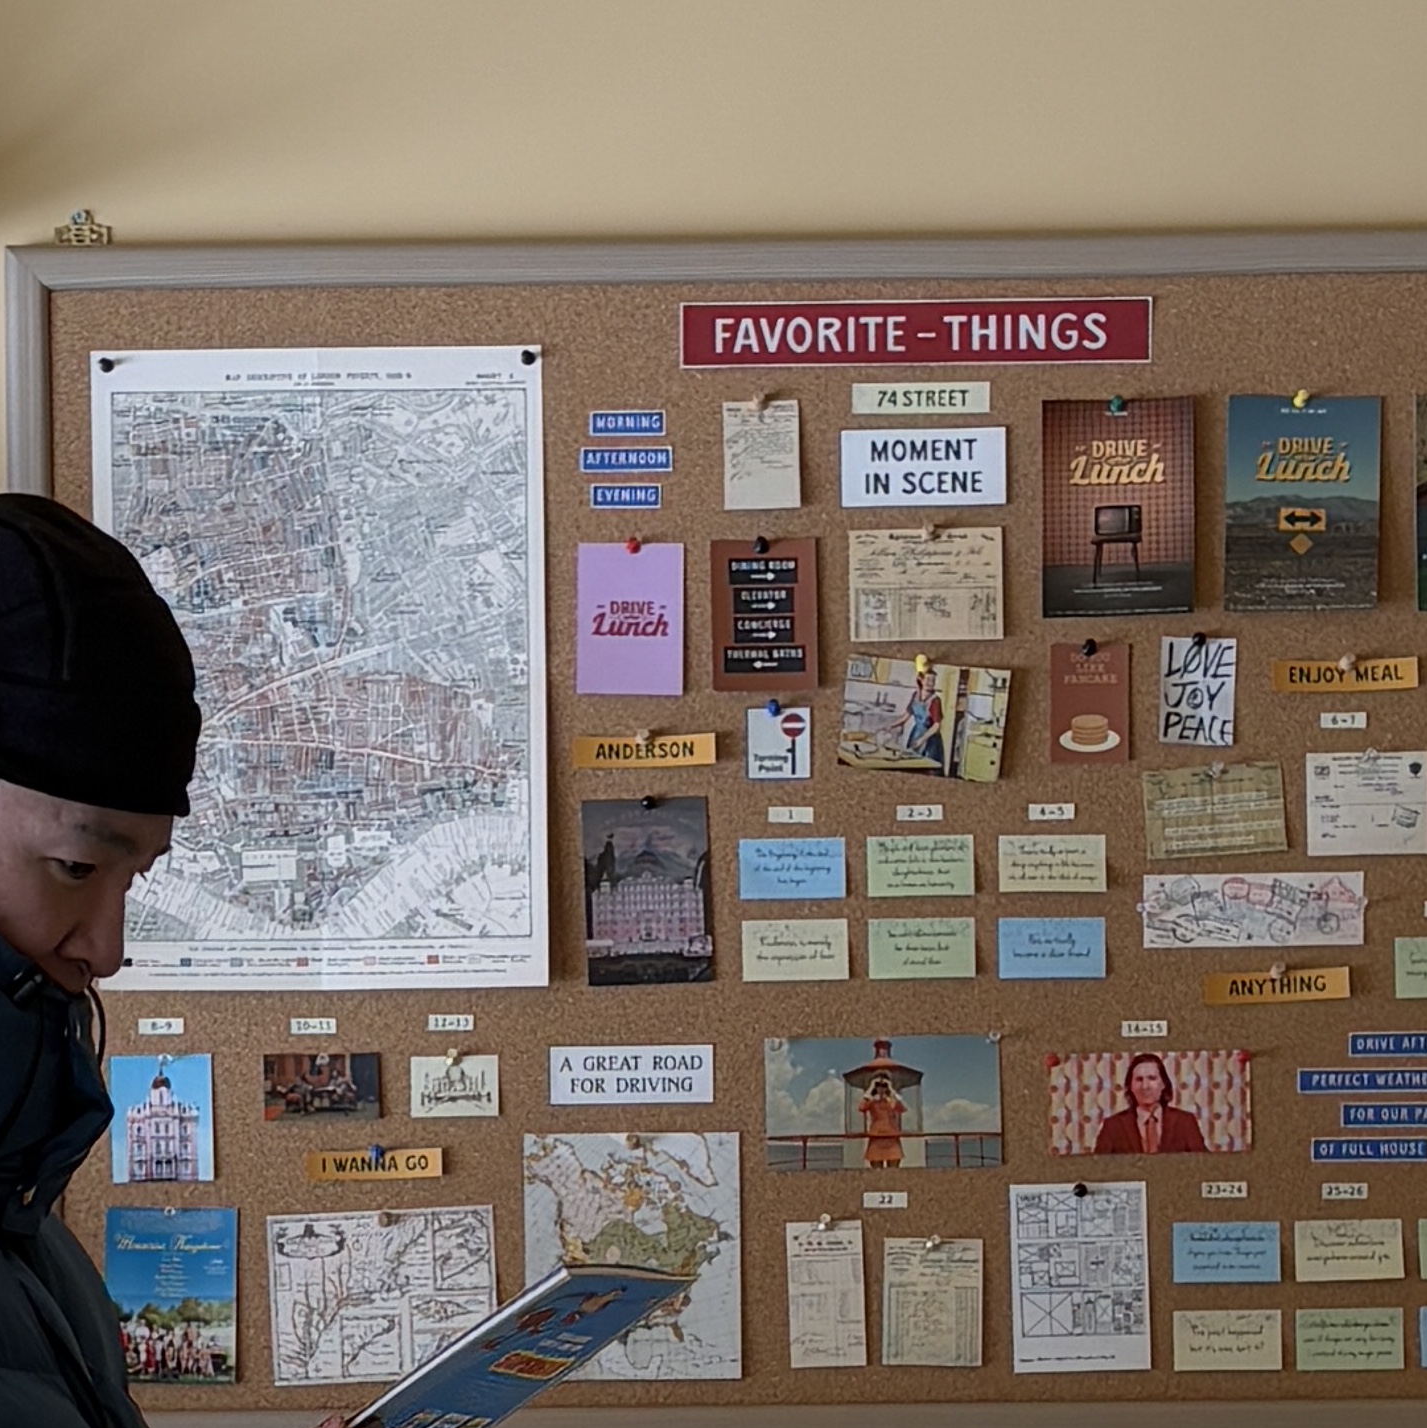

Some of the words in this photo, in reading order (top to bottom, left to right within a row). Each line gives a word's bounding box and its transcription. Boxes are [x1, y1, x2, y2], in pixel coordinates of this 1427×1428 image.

[877, 390, 898, 407] 74
[902, 389, 969, 407] STREET
[596, 415, 661, 429] MORNING
[871, 438, 978, 463] MOMENT
[1092, 440, 1148, 458] DRIVE
[1278, 437, 1334, 455] DRIVE
[586, 453, 667, 464] AFTERNOON
[1069, 453, 1165, 487] Lunch
[1256, 453, 1351, 484] Lunch
[865, 473, 890, 494] IN
[902, 470, 984, 494] SCENE
[597, 489, 656, 502] EVENING
[609, 601, 654, 618] DRIVE
[591, 612, 670, 638] Lunch
[1289, 666, 1346, 684] ENJOY
[1355, 664, 1404, 682] MEAL
[1164, 681, 1226, 711] JOY
[1163, 711, 1233, 745] PEACE
[596, 741, 695, 761] ANDERSON
[1229, 975, 1327, 996] ANYTHING
[1127, 1023, 1163, 1034] 14-15
[1356, 1037, 1395, 1050] DRIVE
[559, 1056, 574, 1073] A
[583, 1056, 643, 1072] GREAT
[653, 1055, 704, 1072] ROAD
[571, 1078, 607, 1095] FOR
[615, 1076, 693, 1094] DRIVING
[1311, 1073, 1369, 1087] PERFECT
[1350, 1108, 1373, 1121] FOR
[1381, 1108, 1408, 1120] OUR
[1319, 1144, 1335, 1156] OF
[1342, 1143, 1373, 1155] FULL
[1379, 1141, 1425, 1155] HOUSE
[322, 1156, 327, 1173] I
[333, 1154, 399, 1173] WANNA
[406, 1154, 429, 1171] GO
[1206, 1184, 1242, 1195] 23-24
